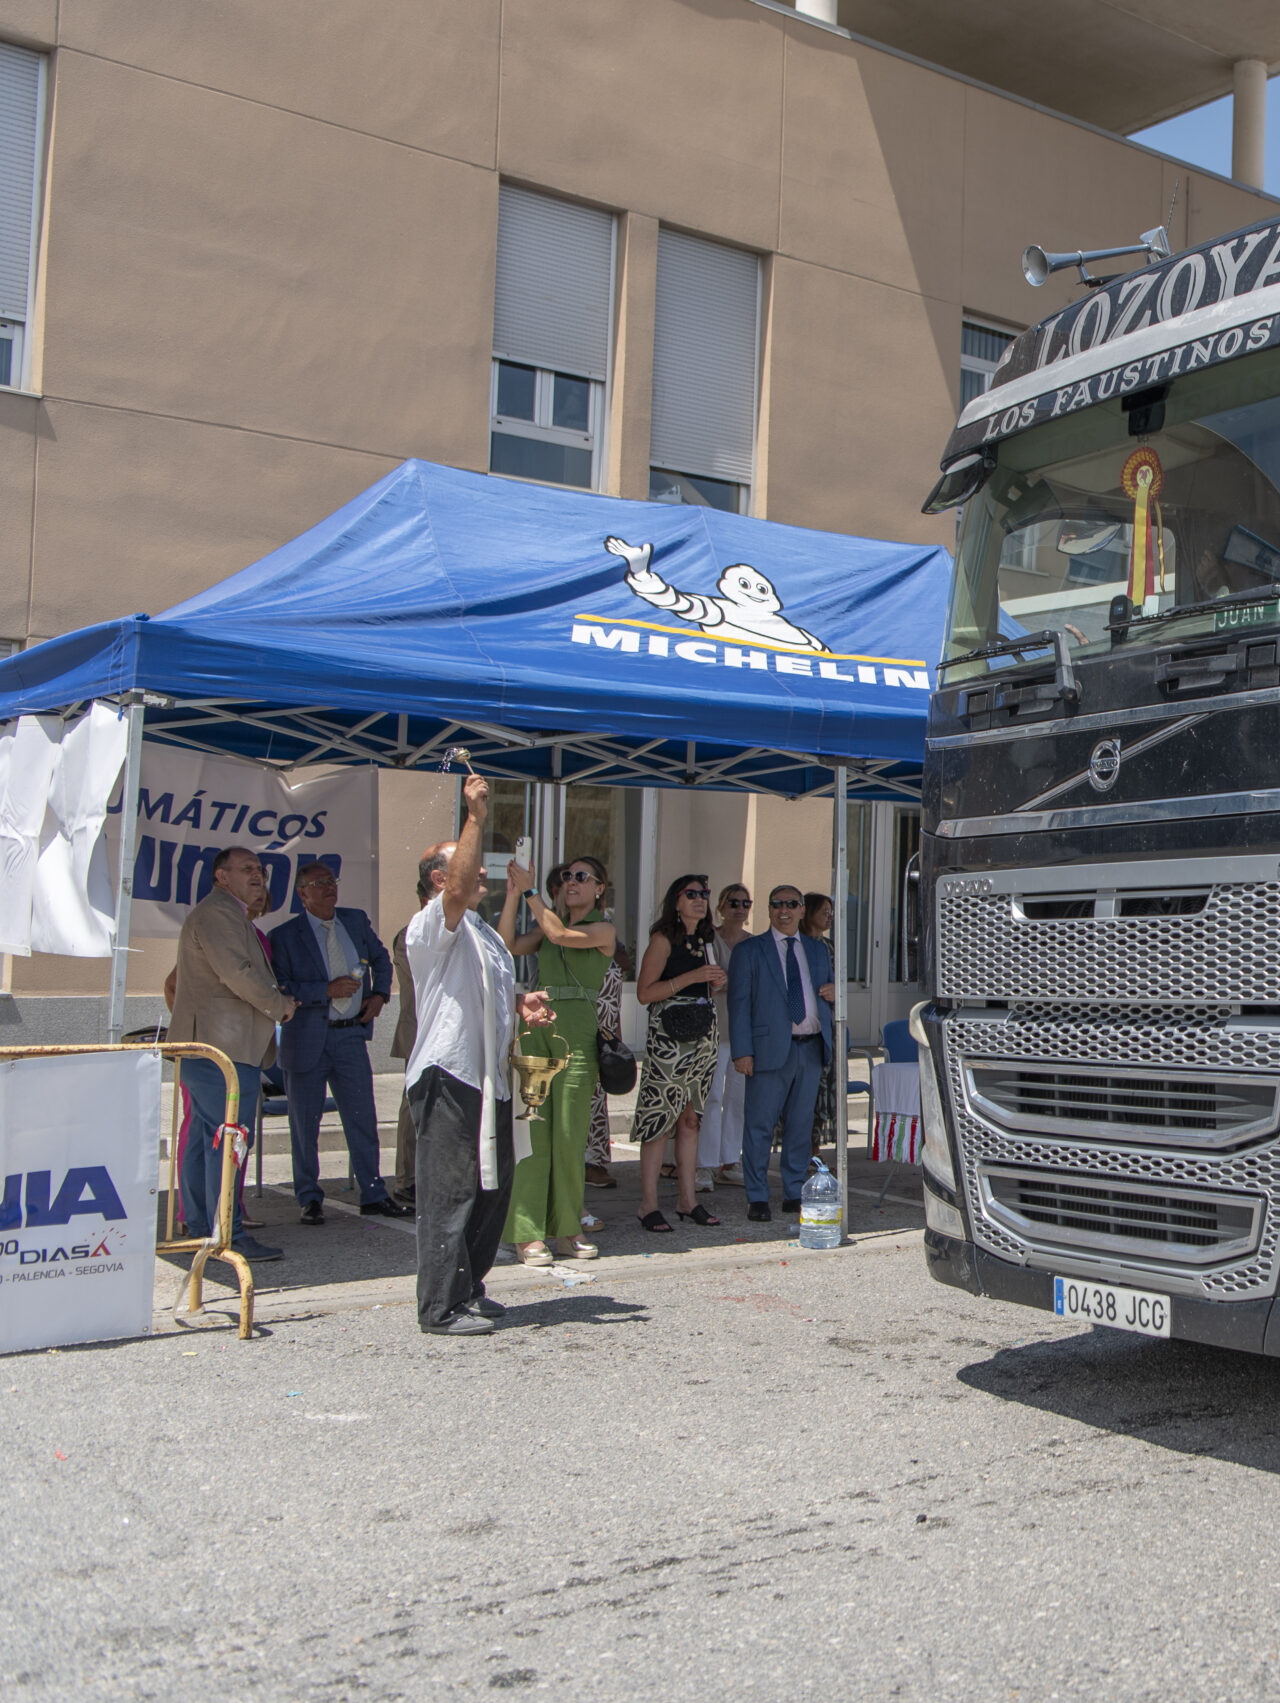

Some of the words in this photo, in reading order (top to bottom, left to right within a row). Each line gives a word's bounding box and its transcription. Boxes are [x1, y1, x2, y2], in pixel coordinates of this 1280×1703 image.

[981, 400, 1039, 442] LOS
[1052, 318, 1274, 416] FAUSTINOS
[571, 623, 931, 690] MICHELIN
[943, 879, 993, 897] VOLVO
[12, 1267, 66, 1283] PALENCIA
[75, 1262, 125, 1276] SEGOVIA
[1068, 1284, 1118, 1322] 0438
[1125, 1295, 1165, 1331] JCG
